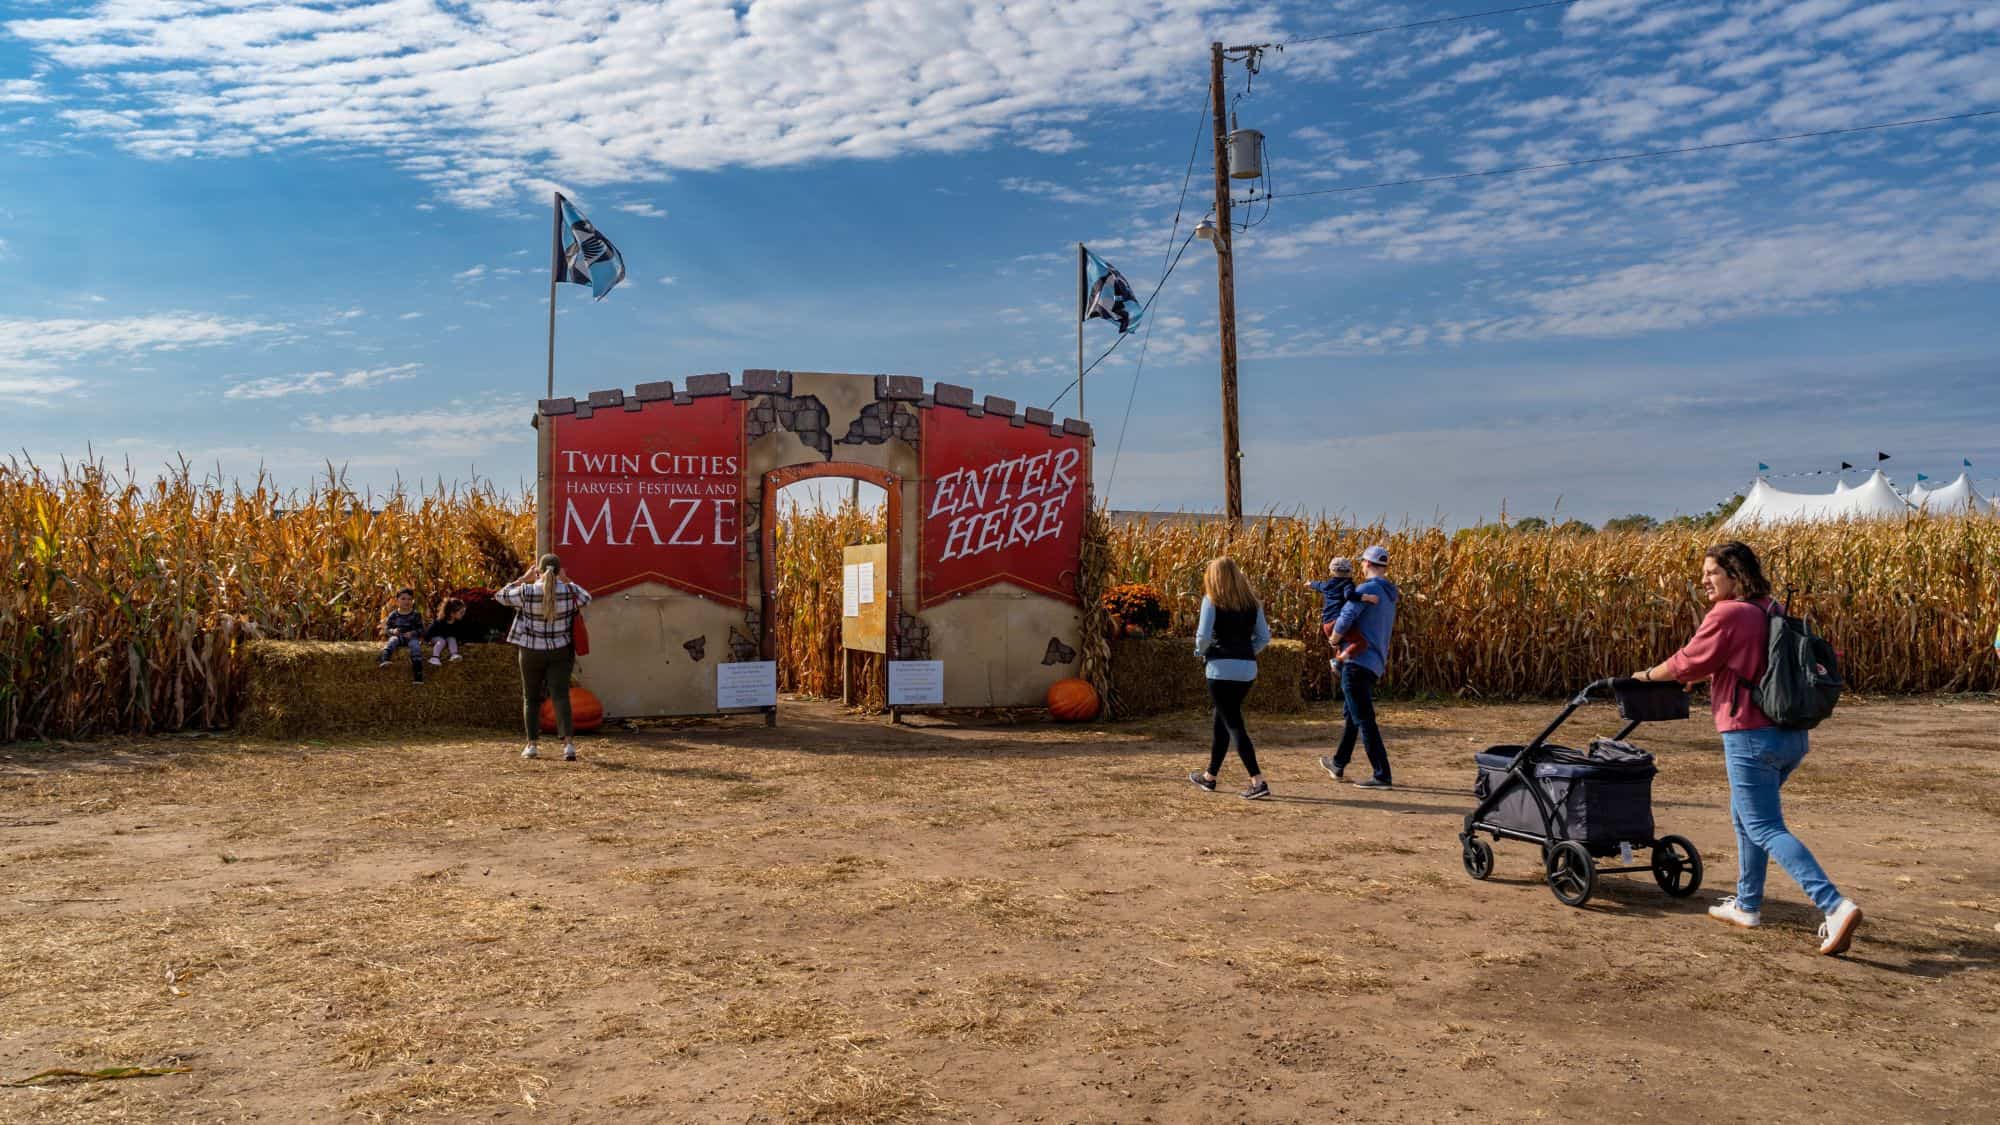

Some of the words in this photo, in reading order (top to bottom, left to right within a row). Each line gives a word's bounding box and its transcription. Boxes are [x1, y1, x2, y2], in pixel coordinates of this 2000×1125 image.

[562, 450, 641, 474] TWIN
[650, 450, 737, 475] CITIES
[927, 447, 1080, 520] ENTER
[566, 480, 634, 495] HARVEST
[638, 480, 702, 495] FESTIVAL
[705, 482, 737, 496] AND
[560, 497, 737, 546] MAZE
[939, 489, 1069, 563] HERE
